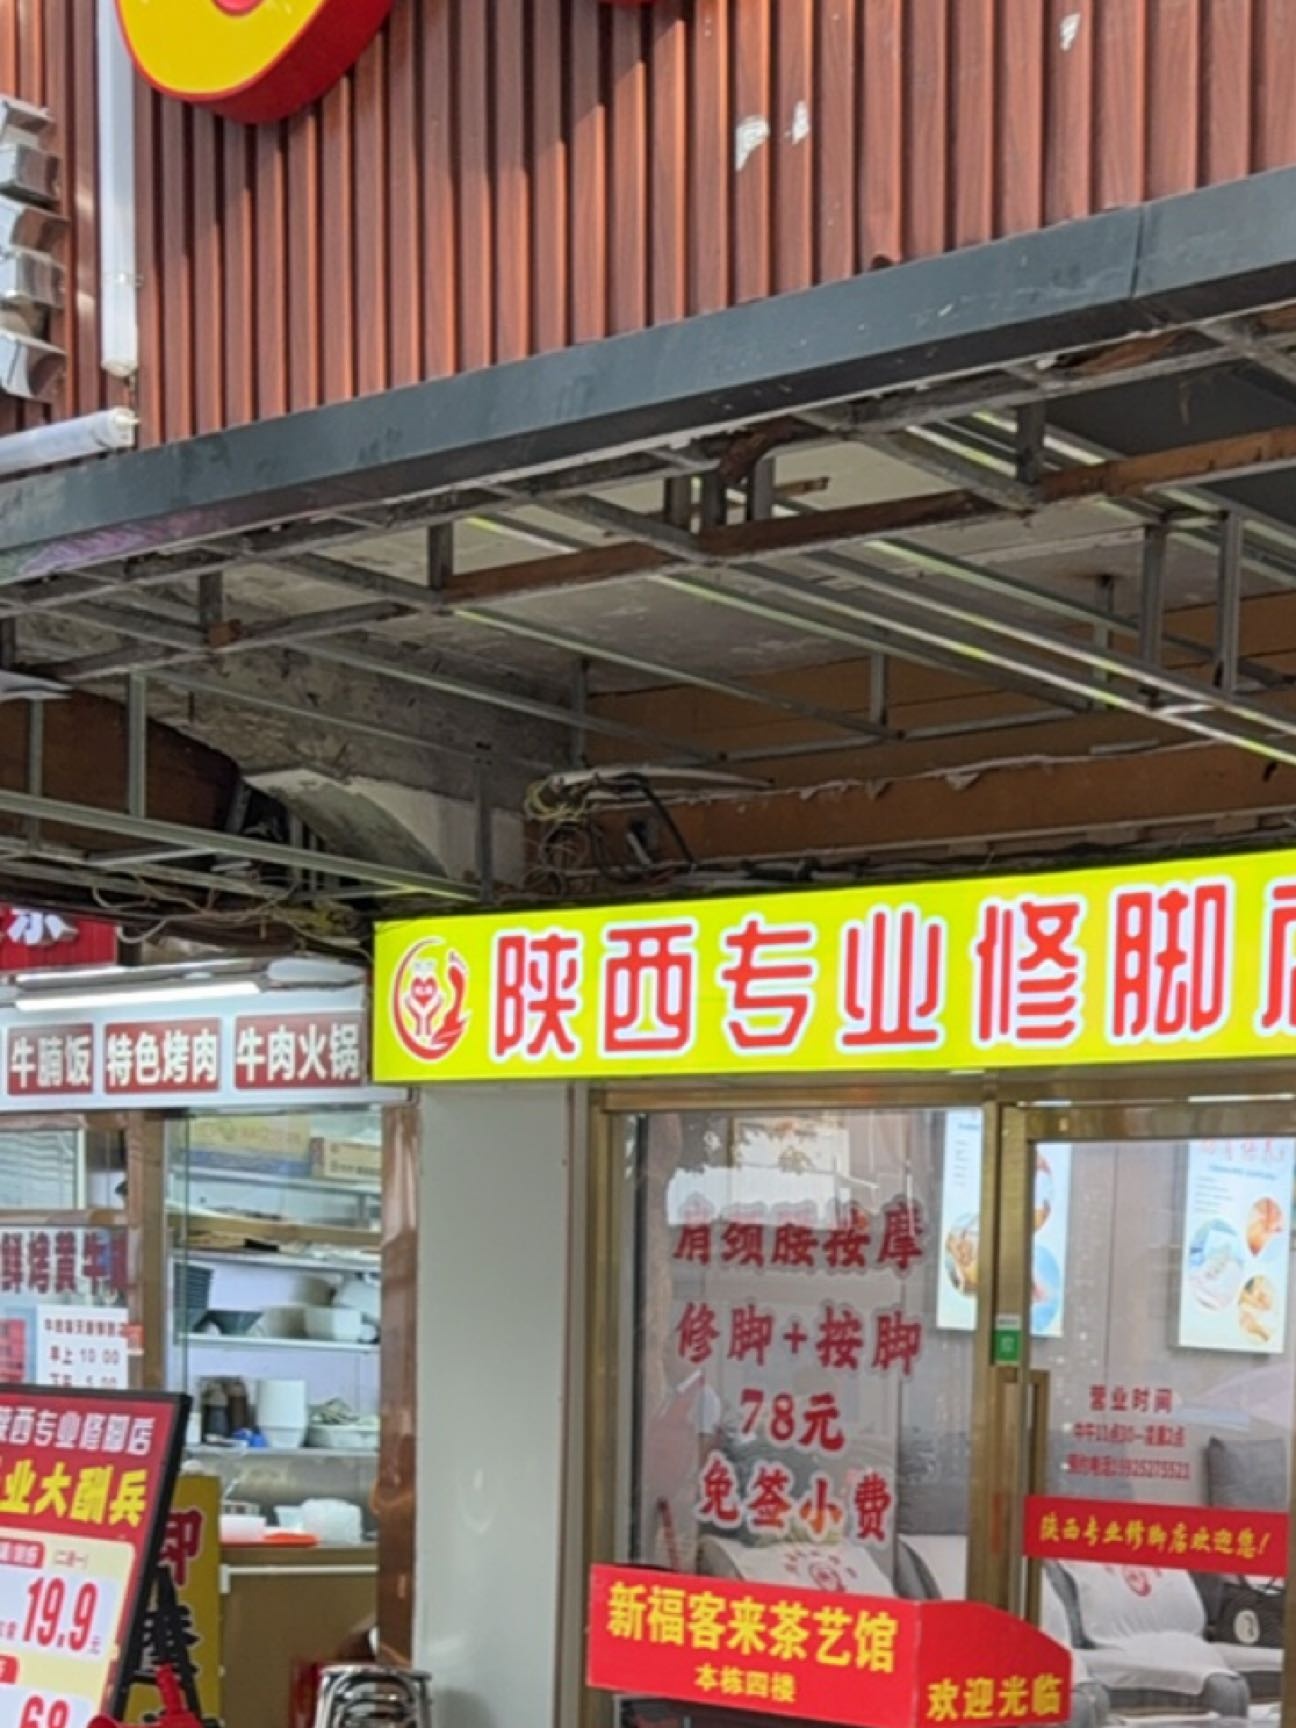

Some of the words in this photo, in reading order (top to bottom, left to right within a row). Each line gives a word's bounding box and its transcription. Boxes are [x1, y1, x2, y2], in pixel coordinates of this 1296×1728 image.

[107, 1028, 218, 1086] 特色烤肉
[237, 1023, 361, 1082] 牛肉火锅
[672, 1197, 923, 1270] 肩颈腰按摩
[675, 1301, 922, 1376] 修脚+按脚
[740, 1388, 846, 1452] 78元
[1089, 1384, 1173, 1414] 营业时间
[699, 1459, 893, 1542] 免签小费
[23, 1576, 98, 1651] 19.9
[606, 1580, 899, 1673] 新福客来茶艺馆
[694, 1662, 797, 1703] 本栋四楼
[926, 1672, 1063, 1721] 欢迎光临
